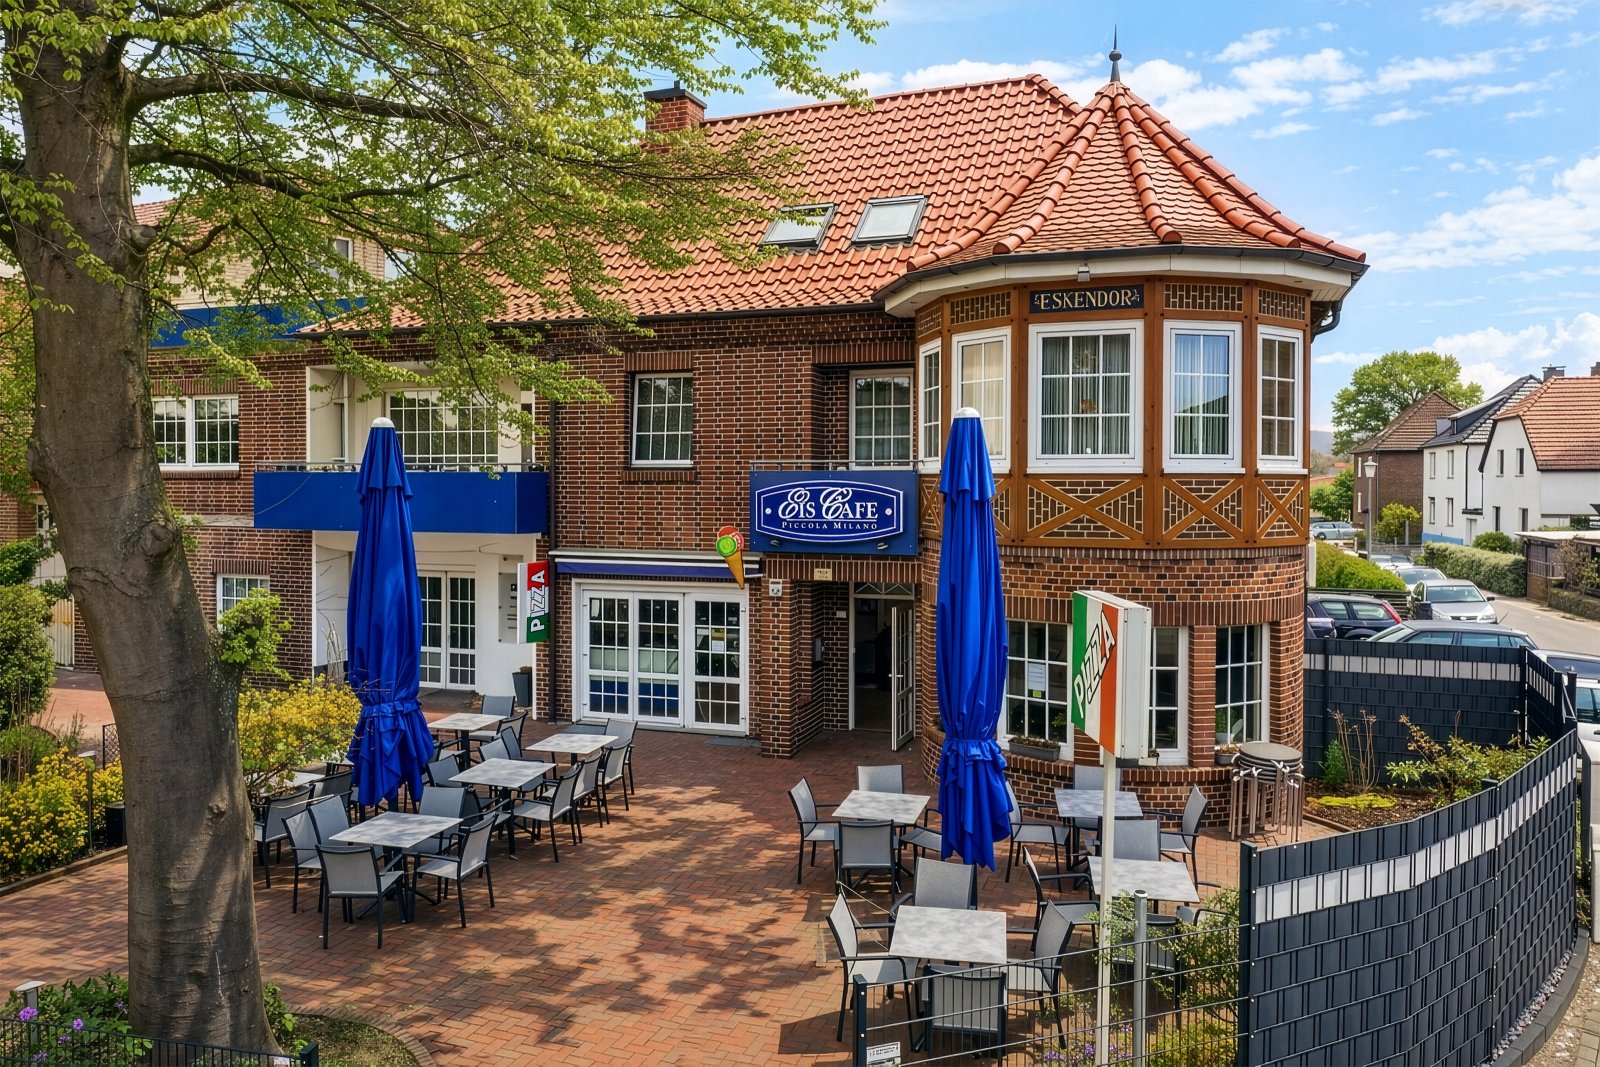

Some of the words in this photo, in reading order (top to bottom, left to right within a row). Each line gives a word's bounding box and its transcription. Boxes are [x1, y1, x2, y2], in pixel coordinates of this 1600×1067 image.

[1040, 289, 1132, 310] ESKENDOR
[778, 487, 816, 519] EIS
[820, 487, 879, 519] CAFE
[781, 521, 828, 529] PICCOLA
[833, 521, 878, 530] MILANO
[530, 569, 546, 632] PIZZA
[1073, 609, 1116, 719] PIZZA
